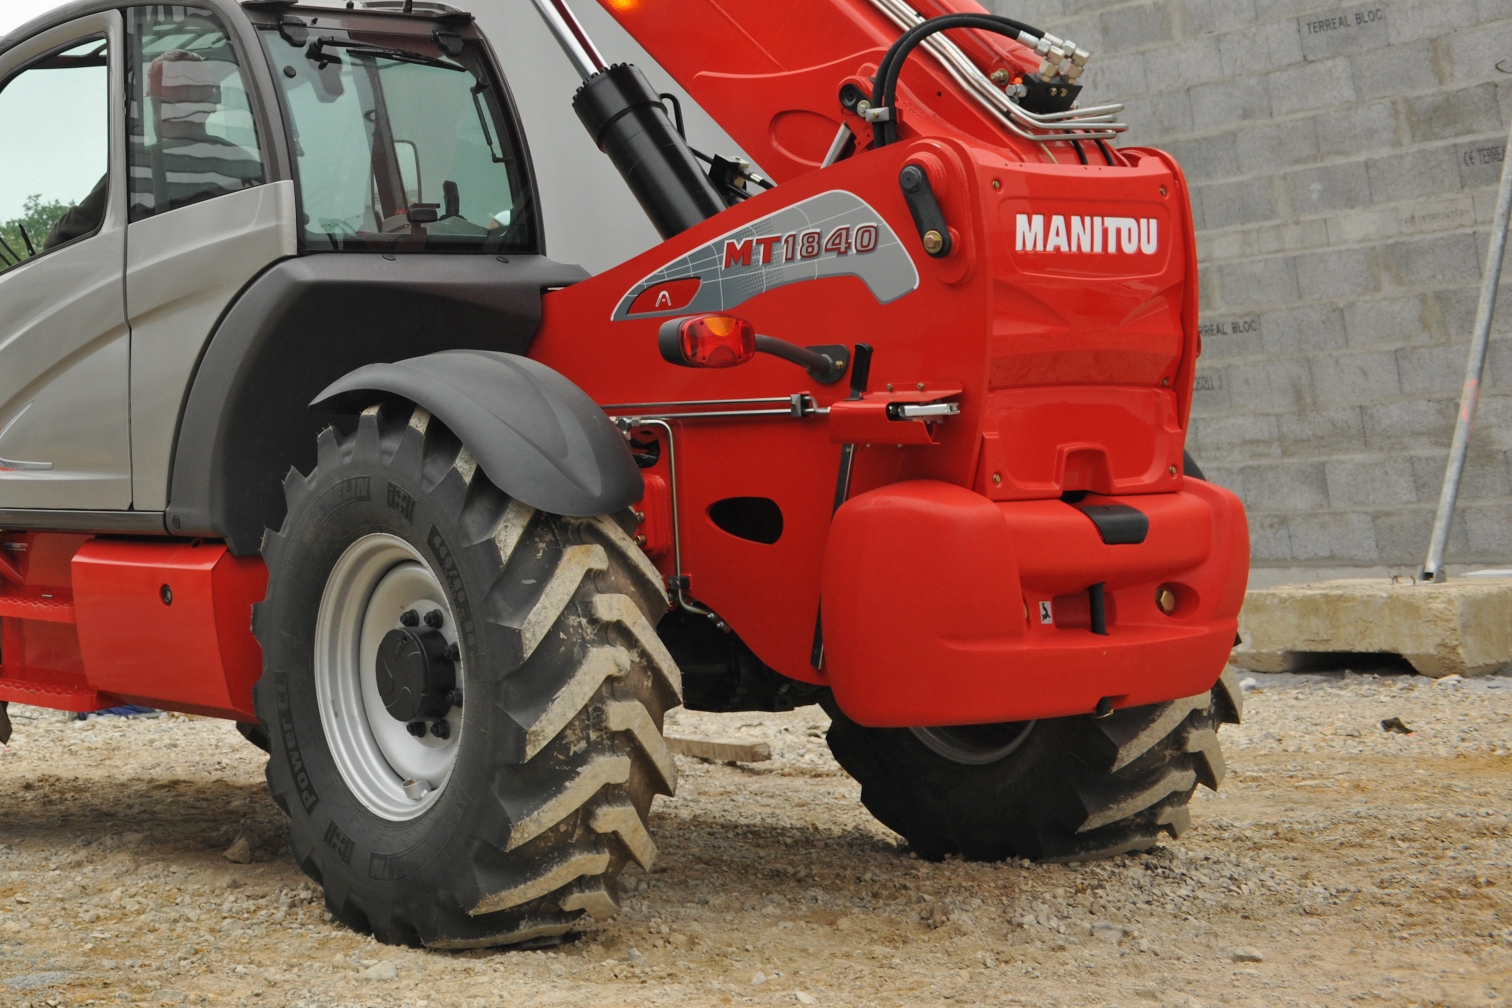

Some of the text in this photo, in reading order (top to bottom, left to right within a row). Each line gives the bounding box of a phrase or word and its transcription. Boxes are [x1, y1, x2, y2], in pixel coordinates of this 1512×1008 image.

[1306, 8, 1383, 35] TERREAL BLOC
[721, 223, 879, 272] MT1840
[1015, 213, 1158, 255] MANITOU
[1198, 320, 1258, 338] RREAL BLOC
